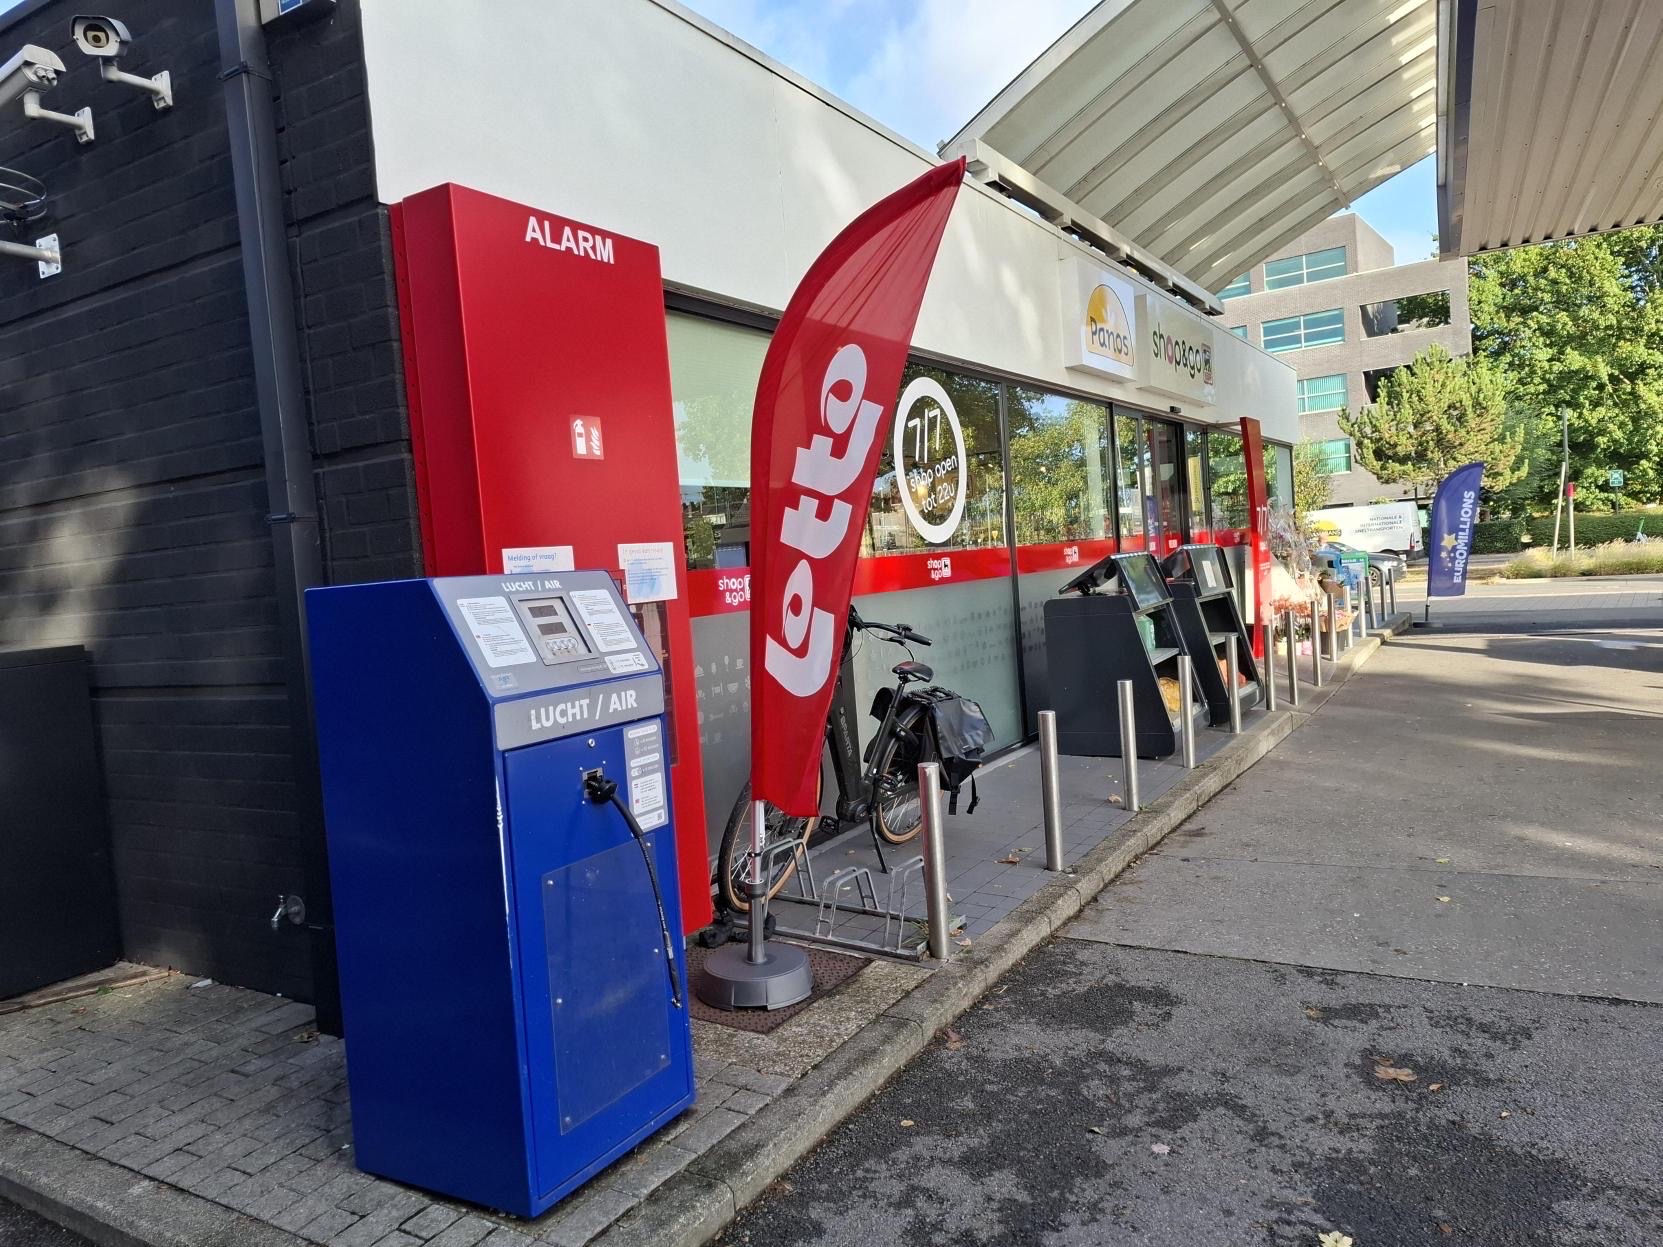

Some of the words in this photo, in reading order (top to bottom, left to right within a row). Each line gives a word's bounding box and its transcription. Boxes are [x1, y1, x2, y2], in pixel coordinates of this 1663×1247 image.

[525, 215, 615, 265] ALARM
[1089, 315, 1129, 356] Panos
[1152, 321, 1202, 379] shop&go
[910, 468, 934, 492] shop
[934, 455, 958, 479] open
[921, 491, 937, 513] tot
[936, 482, 955, 504] 22u
[764, 343, 884, 697] Lotto
[1453, 490, 1476, 584] EUROMILLIONS
[507, 554, 531, 563] Melding
[927, 557, 942, 570] shop
[501, 581, 535, 592] LUCHT
[544, 580, 562, 589] AIR
[718, 576, 744, 592] shop
[725, 591, 745, 606] &go
[530, 698, 590, 730] LUCHT
[595, 693, 604, 720] /
[608, 689, 638, 713] AIR
[840, 715, 853, 758] SPARTA
